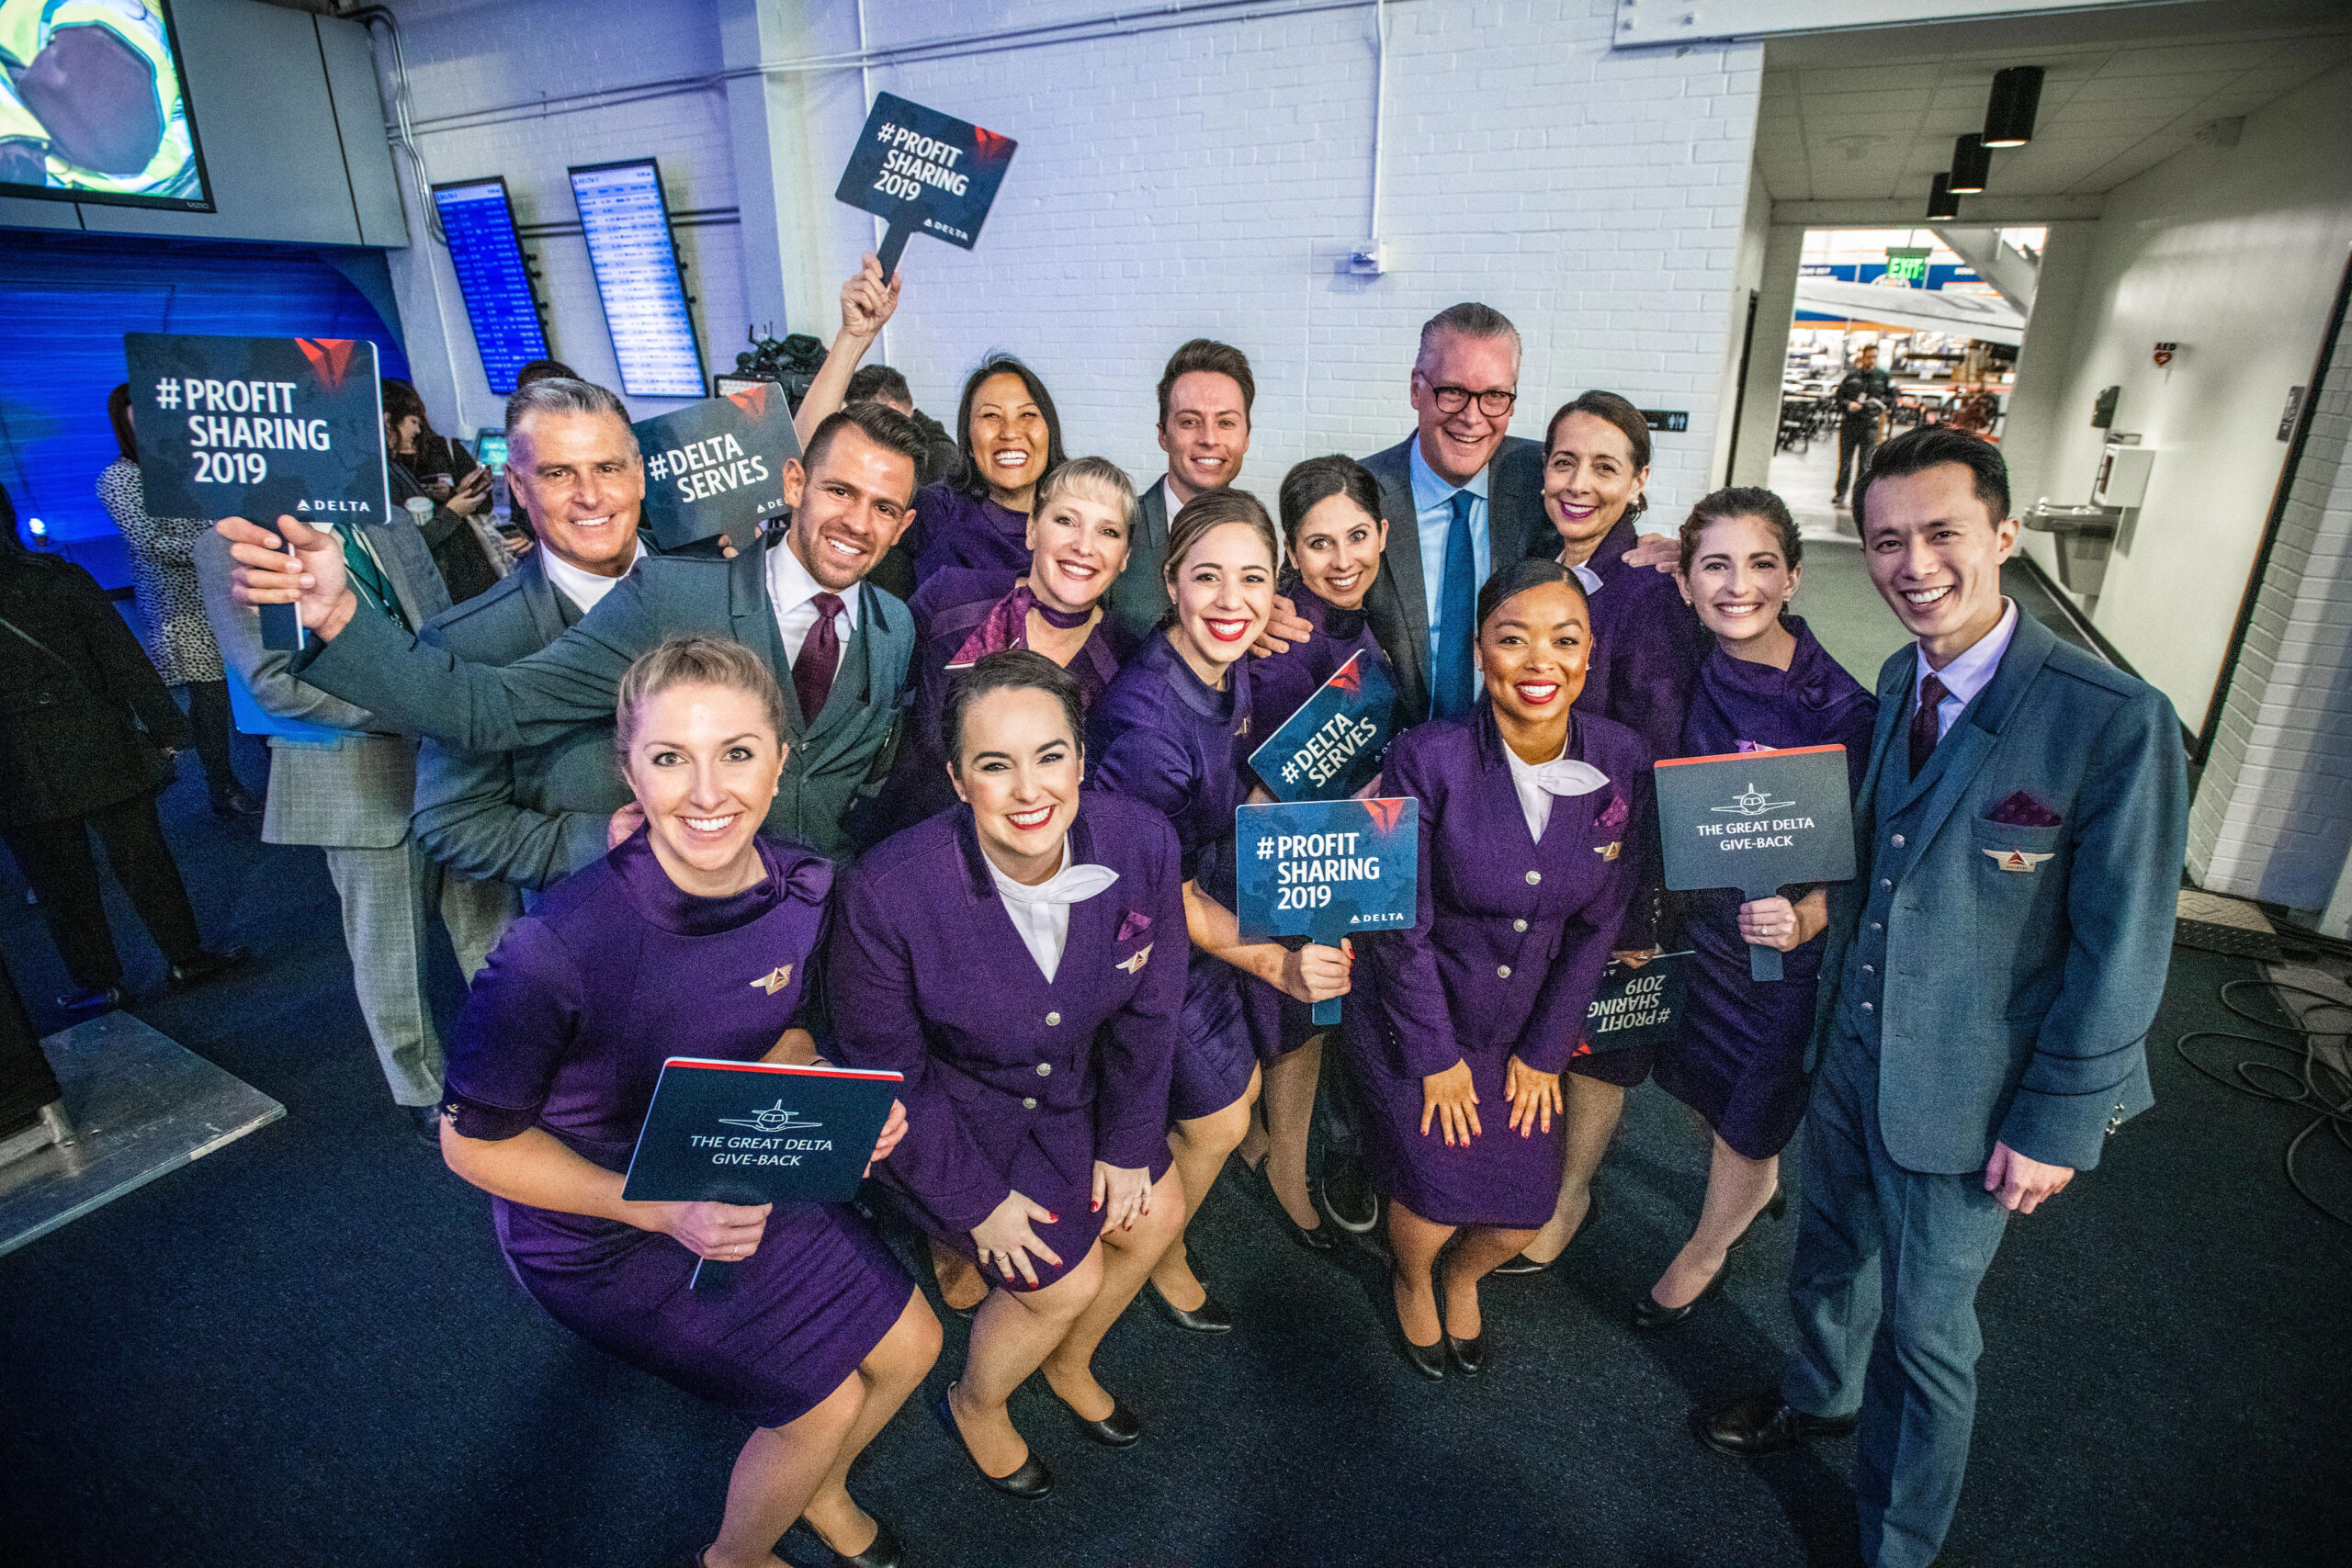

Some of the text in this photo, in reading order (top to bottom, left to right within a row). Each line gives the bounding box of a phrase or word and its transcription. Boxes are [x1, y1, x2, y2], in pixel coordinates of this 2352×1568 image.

[877, 122, 963, 168] #PROFIT
[874, 170, 922, 201] 2019
[883, 149, 969, 197] SHARING
[933, 221, 968, 241] DELTA
[1888, 257, 1924, 279] EXIT
[2154, 343, 2177, 351] AED
[156, 378, 297, 413] #PROFIT
[187, 415, 331, 451] SHARING
[191, 451, 267, 484] 2019
[648, 433, 744, 481] #DELTA
[677, 456, 769, 503] SERVES
[314, 500, 370, 512] DELTA
[1281, 712, 1354, 784] #DELTA
[1308, 716, 1377, 788] SERVES
[1697, 817, 1815, 836] THE GREAT DELTA
[1256, 832, 1360, 860] #PROFIT
[1720, 835, 1793, 851] GIVE-BACK
[1277, 856, 1380, 885] SHARING
[1277, 885, 1332, 910] 2019
[1363, 912, 1404, 922] DELTA
[1625, 975, 1667, 995] 2019
[1587, 992, 1661, 1019] SHARING
[1597, 1007, 1671, 1033] #PROFIT
[690, 1135, 832, 1151] THE GREAT DELTA
[712, 1153, 803, 1167] GIVE-BACK
